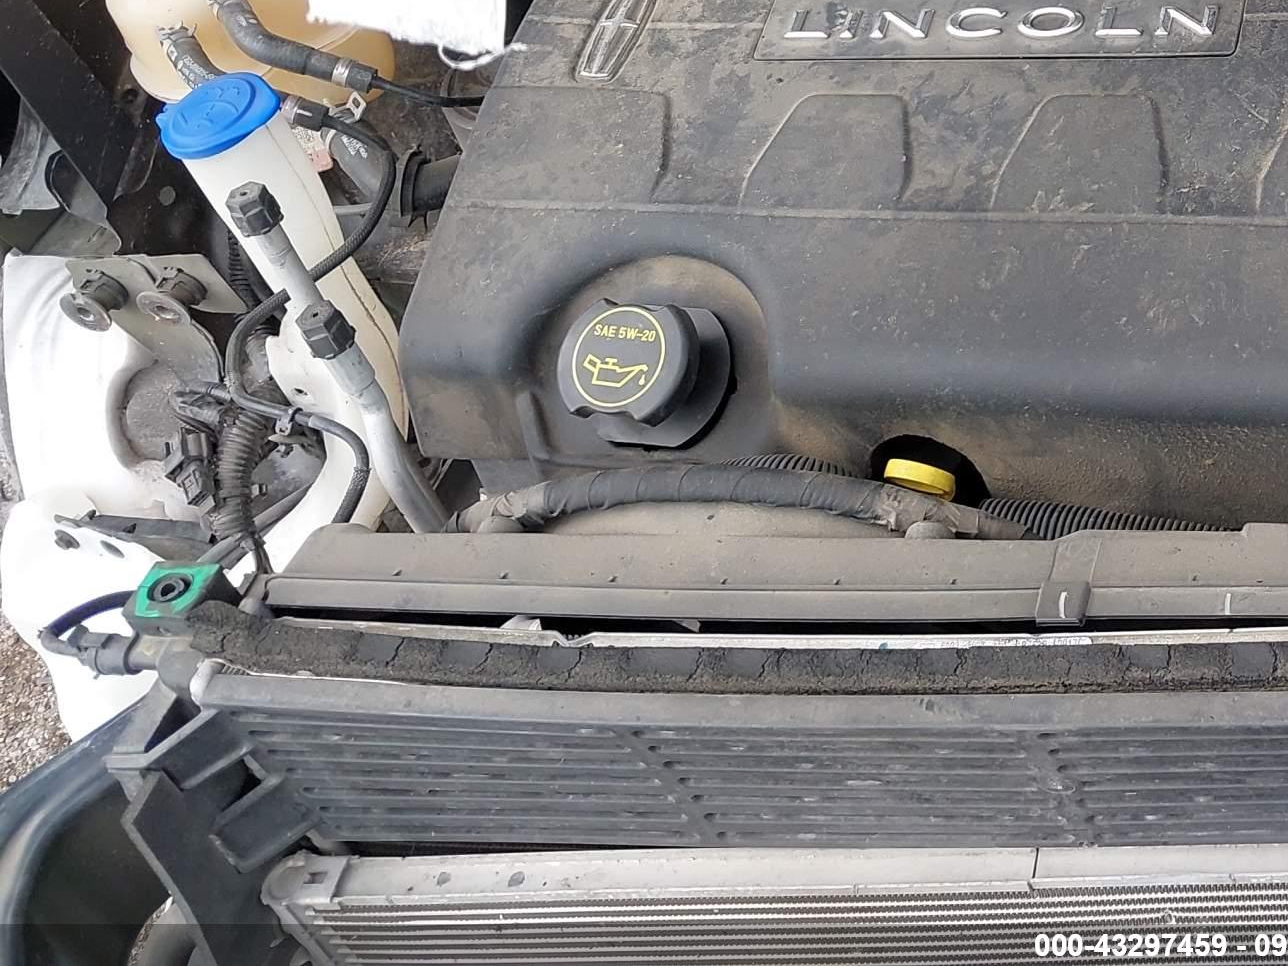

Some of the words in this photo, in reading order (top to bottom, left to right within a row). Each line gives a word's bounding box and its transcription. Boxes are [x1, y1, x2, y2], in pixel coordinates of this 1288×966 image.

[783, 4, 1221, 39] LINCOLN
[594, 324, 617, 338] SAE
[618, 326, 656, 342] 5W-20
